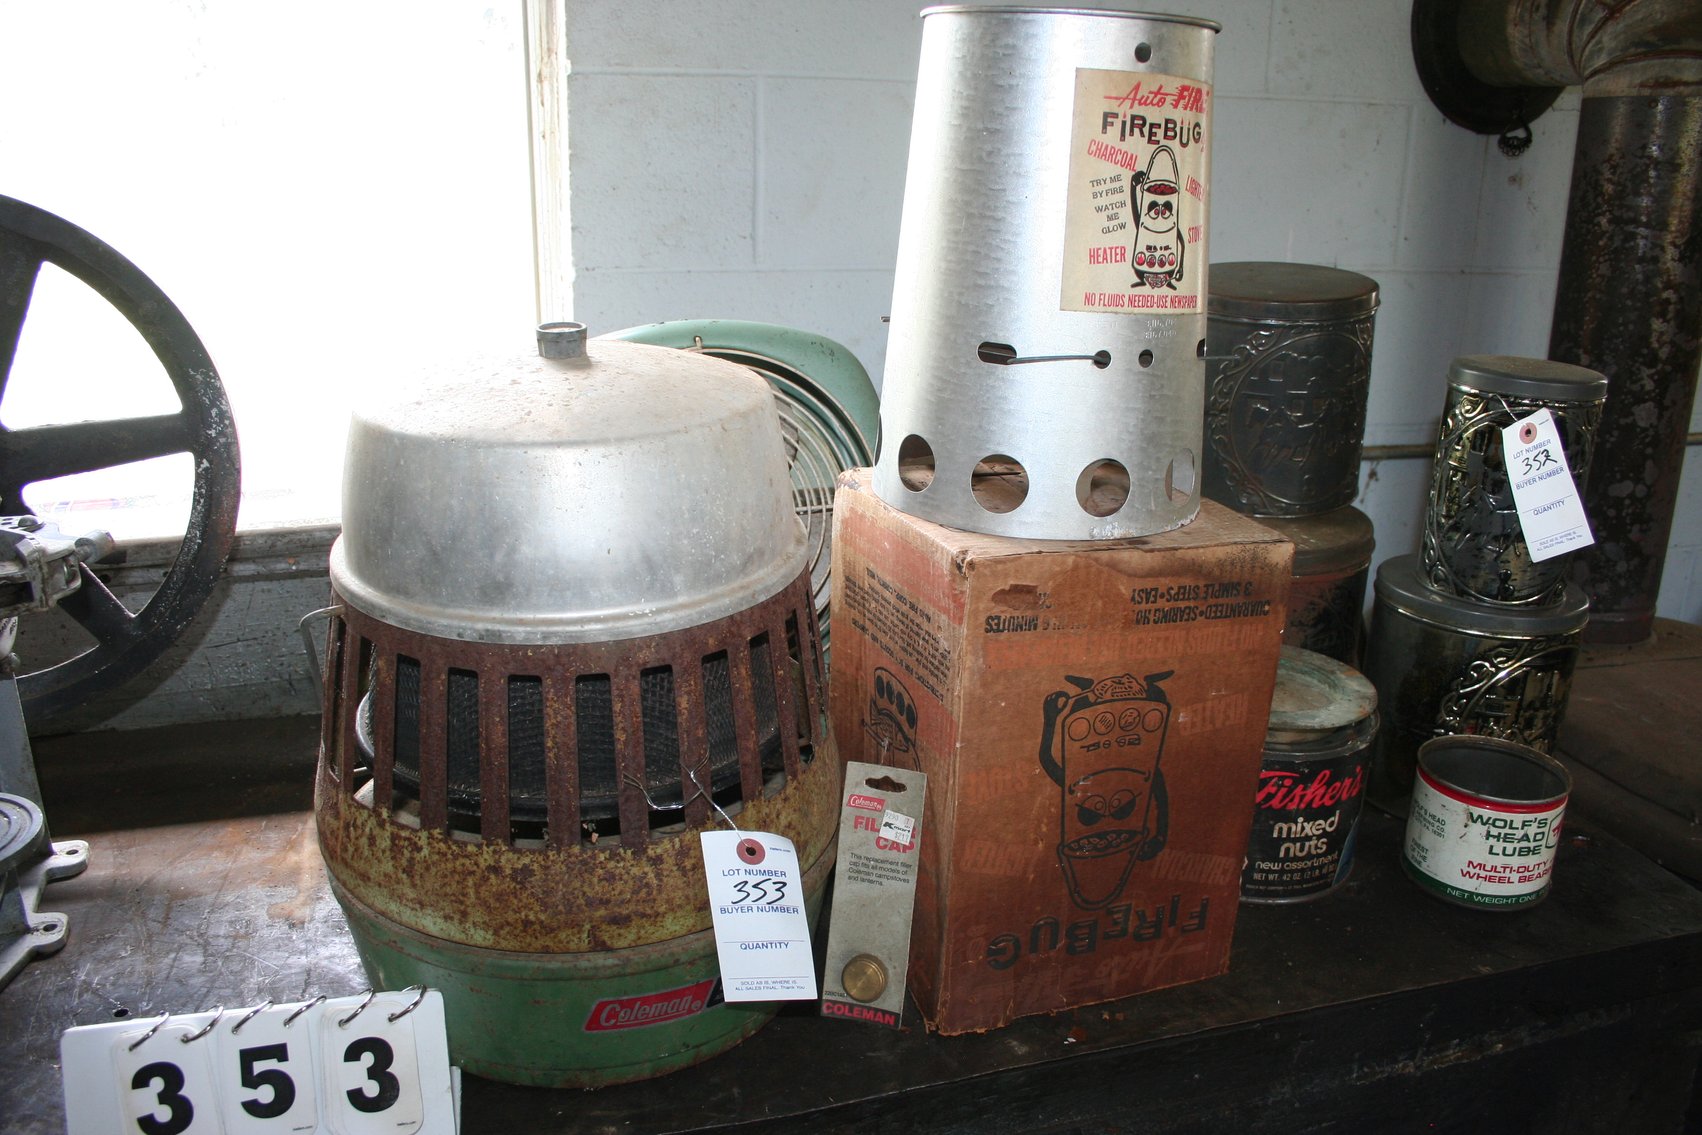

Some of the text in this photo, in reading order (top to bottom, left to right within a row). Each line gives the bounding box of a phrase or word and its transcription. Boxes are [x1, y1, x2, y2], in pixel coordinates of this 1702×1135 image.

[1104, 81, 1172, 109] Auto
[1087, 138, 1138, 172] CHARCOAL
[1089, 174, 1122, 188] TRY ME
[1092, 186, 1124, 200] BY FIRE
[1094, 200, 1127, 213] WATCH
[1106, 212, 1120, 222] ME
[1101, 222, 1127, 234] GLOW
[1089, 246, 1126, 264] HEATER
[1084, 292, 1096, 306] NO
[1098, 293, 1126, 308] FLUIDS
[1512, 438, 1552, 460] LOT NUMBER
[1515, 466, 1565, 490] BUYER NUMBER
[1532, 500, 1566, 516] QUANTITY
[1203, 582, 1241, 600] SIMPLE
[984, 615, 1038, 633] MINUTES
[850, 795, 878, 809] Coleman
[1272, 810, 1340, 838] mixed
[1428, 812, 1446, 827] HEAD
[1469, 811, 1549, 831] WOLF'S
[1486, 827, 1546, 844] HEAD
[875, 836, 915, 853] CAP
[1279, 836, 1328, 858] nuts
[1488, 844, 1543, 857] LUBE
[850, 852, 862, 860] This
[863, 856, 899, 867] replacement
[1255, 861, 1282, 870] new
[1466, 859, 1549, 875] MULTI-DUTY
[722, 868, 787, 878] LOT NUMBER
[848, 867, 910, 884] Coleman campstoves
[879, 866, 900, 874] models
[1253, 872, 1266, 881] NET
[1460, 869, 1515, 884] WHEEL
[731, 878, 788, 905] 353
[1446, 887, 1469, 900] NET
[1473, 894, 1517, 905] WEIGHT
[720, 906, 799, 915] BUYER NUMBER
[739, 941, 790, 951] QUANTITY
[600, 996, 693, 1027] Coleman
[823, 1001, 896, 1025] COLEMAN
